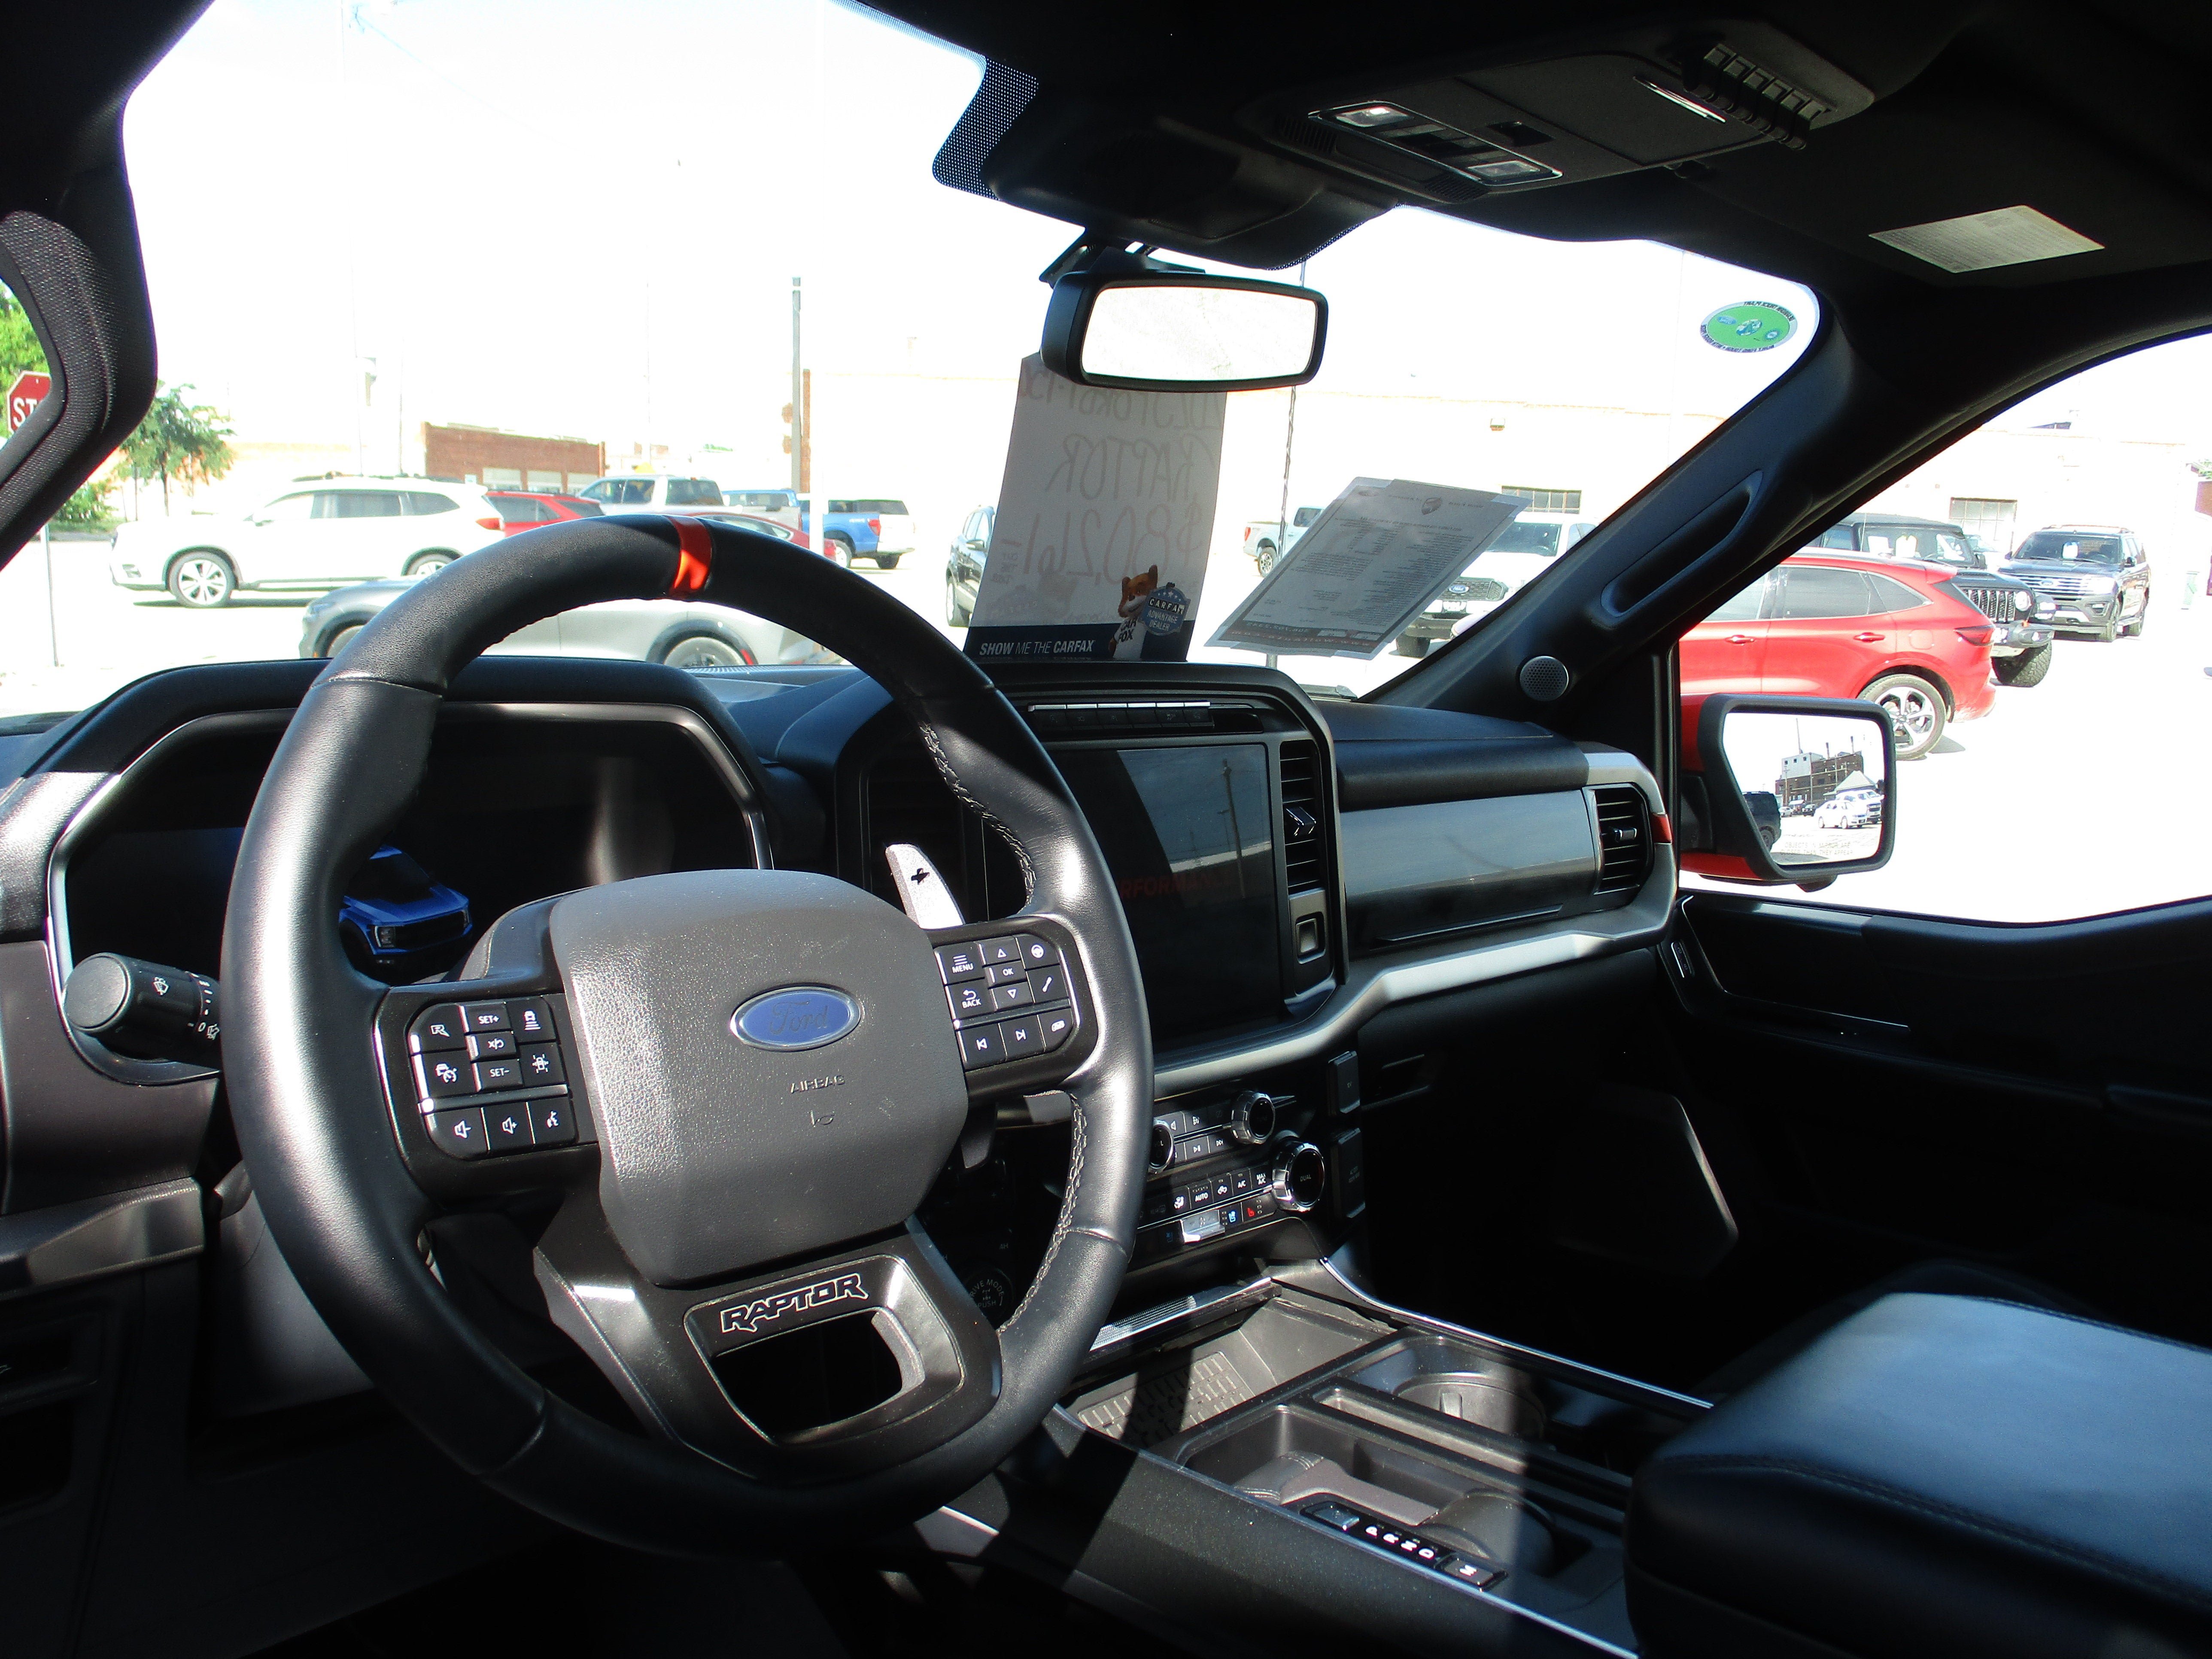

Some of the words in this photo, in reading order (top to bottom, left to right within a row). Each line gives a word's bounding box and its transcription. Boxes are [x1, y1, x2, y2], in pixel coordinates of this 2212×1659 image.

[13, 397, 38, 428] ST
[1149, 597, 1185, 614] CARFAX
[1147, 610, 1179, 624] ADVANTAGE
[1149, 620, 1170, 632] DEALER
[979, 643, 1014, 655] SHOW
[1015, 642, 1032, 654] ME
[1033, 641, 1052, 654] THE
[1053, 640, 1095, 653] CARFAX
[951, 963, 973, 974] MENU
[961, 998, 982, 1009] BACK
[770, 999, 829, 1036] Ford
[790, 1074, 845, 1094] AIRBAG
[1195, 1193, 1209, 1202] AUTO
[969, 1280, 985, 1297] RIVE
[987, 1279, 1005, 1297] MODE
[720, 1273, 869, 1332] RAPTOR
[978, 1300, 997, 1308] PUSH
[1383, 1533, 1400, 1544] R
[1401, 1540, 1418, 1552] N
[1419, 1547, 1435, 1559] D
